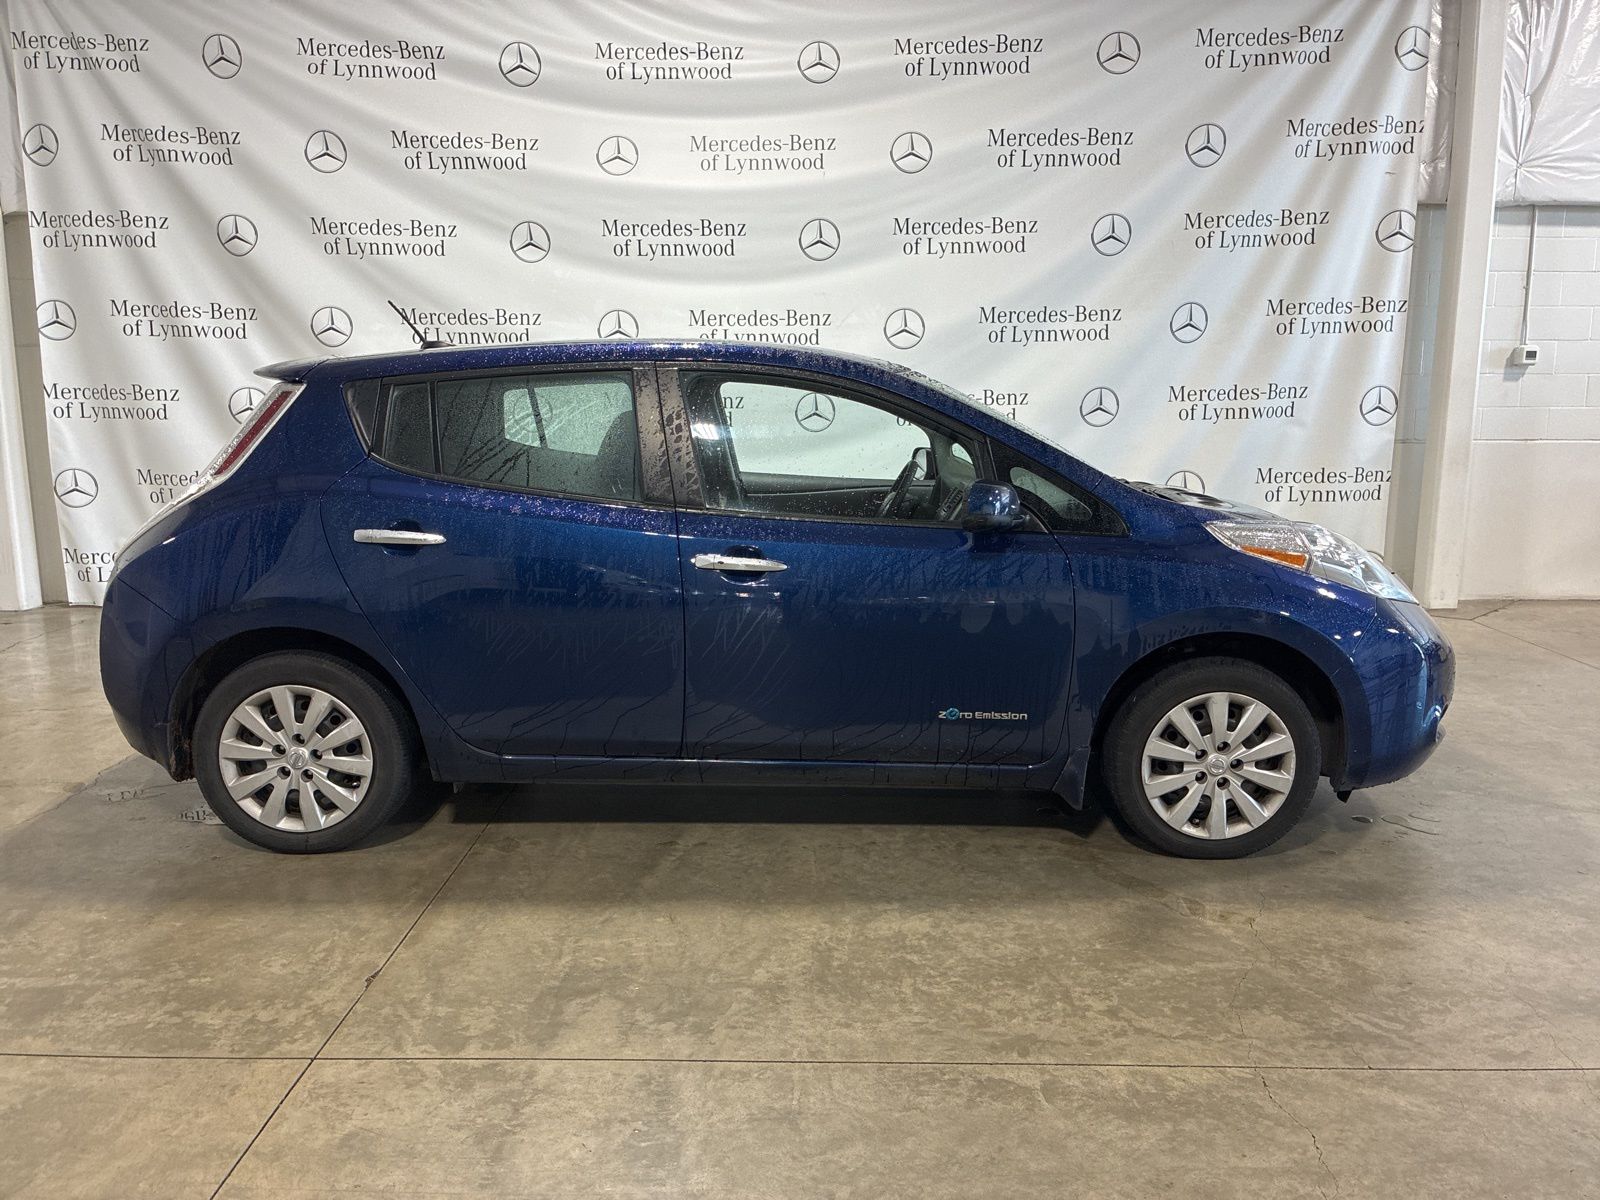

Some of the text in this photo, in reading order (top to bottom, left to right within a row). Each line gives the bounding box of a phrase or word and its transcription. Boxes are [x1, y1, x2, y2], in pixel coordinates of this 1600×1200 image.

[11, 30, 149, 52] Mercedes-Benz
[894, 34, 1043, 55] Mercedes-Benz
[1195, 25, 1344, 47] Mercedes-Benz
[297, 38, 445, 60] Mercedes-Benz
[595, 42, 744, 61] Mercedes-Benz
[1205, 45, 1330, 72] of Lynnwood
[24, 51, 140, 73] of Lynnwood
[307, 58, 436, 81] of Lynnwood
[905, 55, 1030, 81] of Lynnwood
[606, 62, 732, 85] of Lynnwood
[101, 124, 240, 145] Mercedes-Benz
[390, 130, 538, 151] Mercedes-Benz
[690, 134, 836, 152] Mercedes-Benz
[987, 127, 1133, 147] Mercedes-Benz
[113, 144, 233, 167] of Lynnwood
[1295, 136, 1414, 161] of Lynnwood
[404, 151, 527, 175] of Lynnwood
[700, 153, 824, 175] of Lynnwood
[997, 148, 1120, 172] of Lynnwood
[29, 210, 169, 229] Mercedes-Benz
[310, 217, 457, 238] Mercedes-Benz
[602, 219, 746, 237] Mercedes-Benz
[893, 216, 1038, 235] Mercedes-Benz
[1184, 209, 1329, 230] Mercedes-Benz
[43, 230, 156, 252] of Lynnwood
[324, 236, 445, 260] of Lynnwood
[613, 238, 735, 261] of Lynnwood
[903, 235, 1026, 259] of Lynnwood
[1195, 227, 1316, 253] of Lynnwood
[110, 299, 257, 321] Mercedes-Benz
[979, 305, 1121, 324] Mercedes-Benz
[1266, 296, 1408, 316] Mercedes-Benz
[689, 309, 831, 327] Mercedes-Benz
[1276, 315, 1394, 339] of Lynnwood
[123, 319, 247, 341] of Lynnwood
[988, 323, 1109, 347] of Lynnwood
[1168, 383, 1308, 402] Mercedes-Benz
[53, 401, 168, 423] of Lynnwood
[1178, 401, 1295, 424] of Lynnwood
[150, 488, 165, 503] of
[1265, 484, 1381, 506] of Lynnwood
[78, 567, 91, 582] of
[975, 711, 1028, 720] Emission
